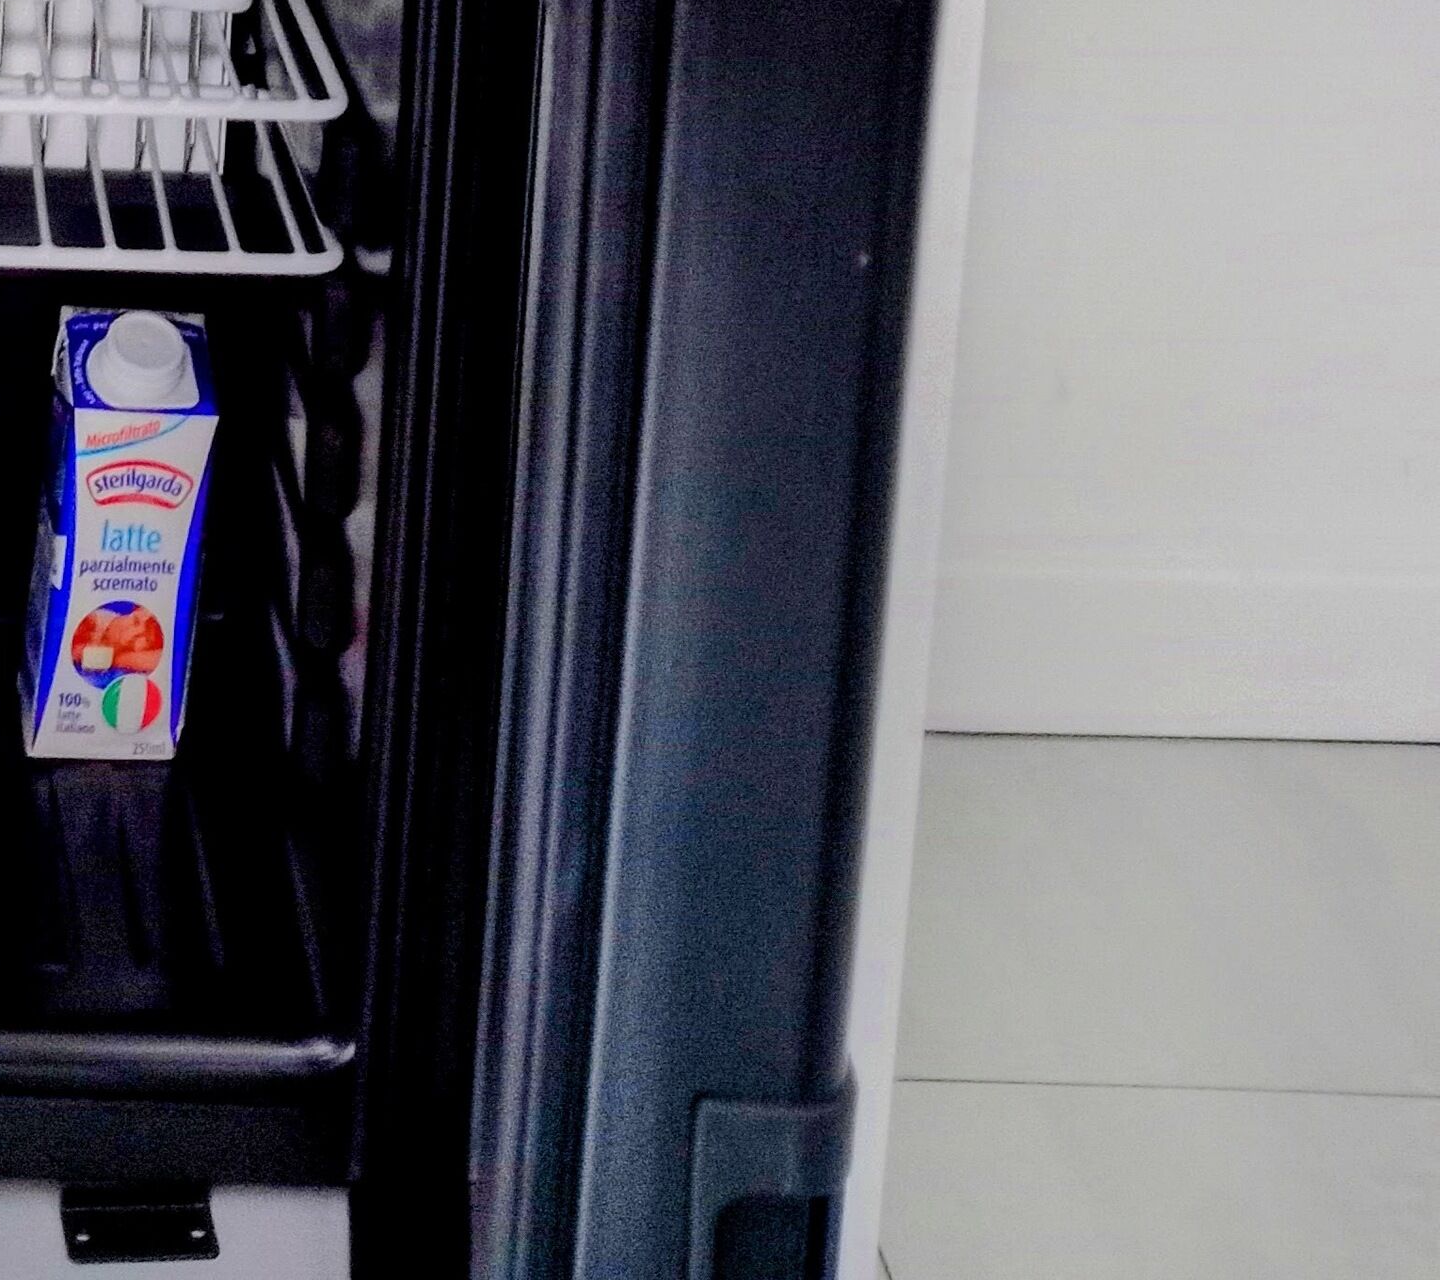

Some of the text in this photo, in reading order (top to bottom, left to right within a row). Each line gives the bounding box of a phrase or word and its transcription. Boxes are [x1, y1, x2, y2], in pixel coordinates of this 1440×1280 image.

[85, 420, 161, 448] Microfiltrato
[94, 468, 183, 497] sterilgarda
[101, 520, 162, 552] latte
[79, 554, 175, 577] parzialmente
[92, 577, 158, 593] scremato
